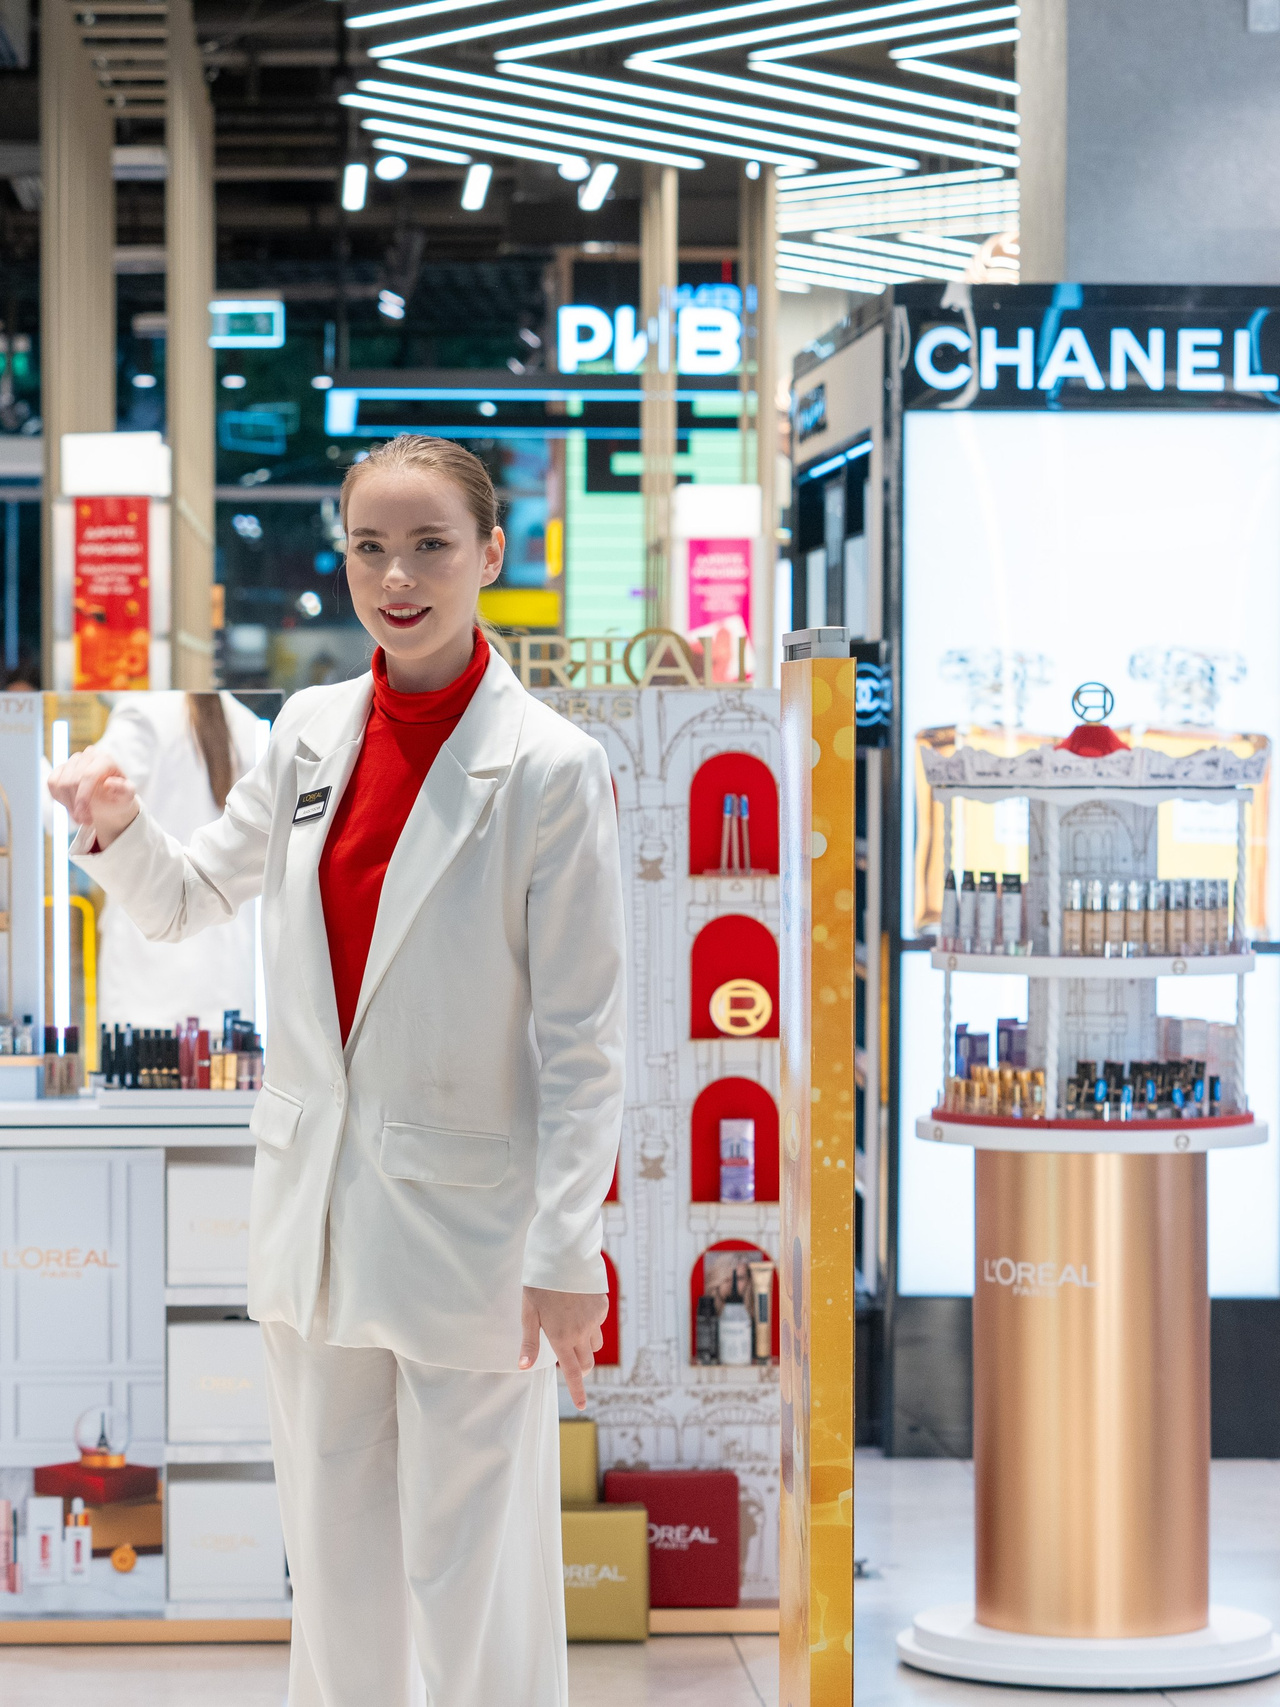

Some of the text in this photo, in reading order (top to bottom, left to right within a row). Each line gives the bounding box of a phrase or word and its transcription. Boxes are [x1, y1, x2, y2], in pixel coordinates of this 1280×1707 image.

[557, 304, 742, 375] РИВ
[914, 325, 1280, 392] CHANEL
[983, 1256, 1100, 1288] L'ORÉAL
